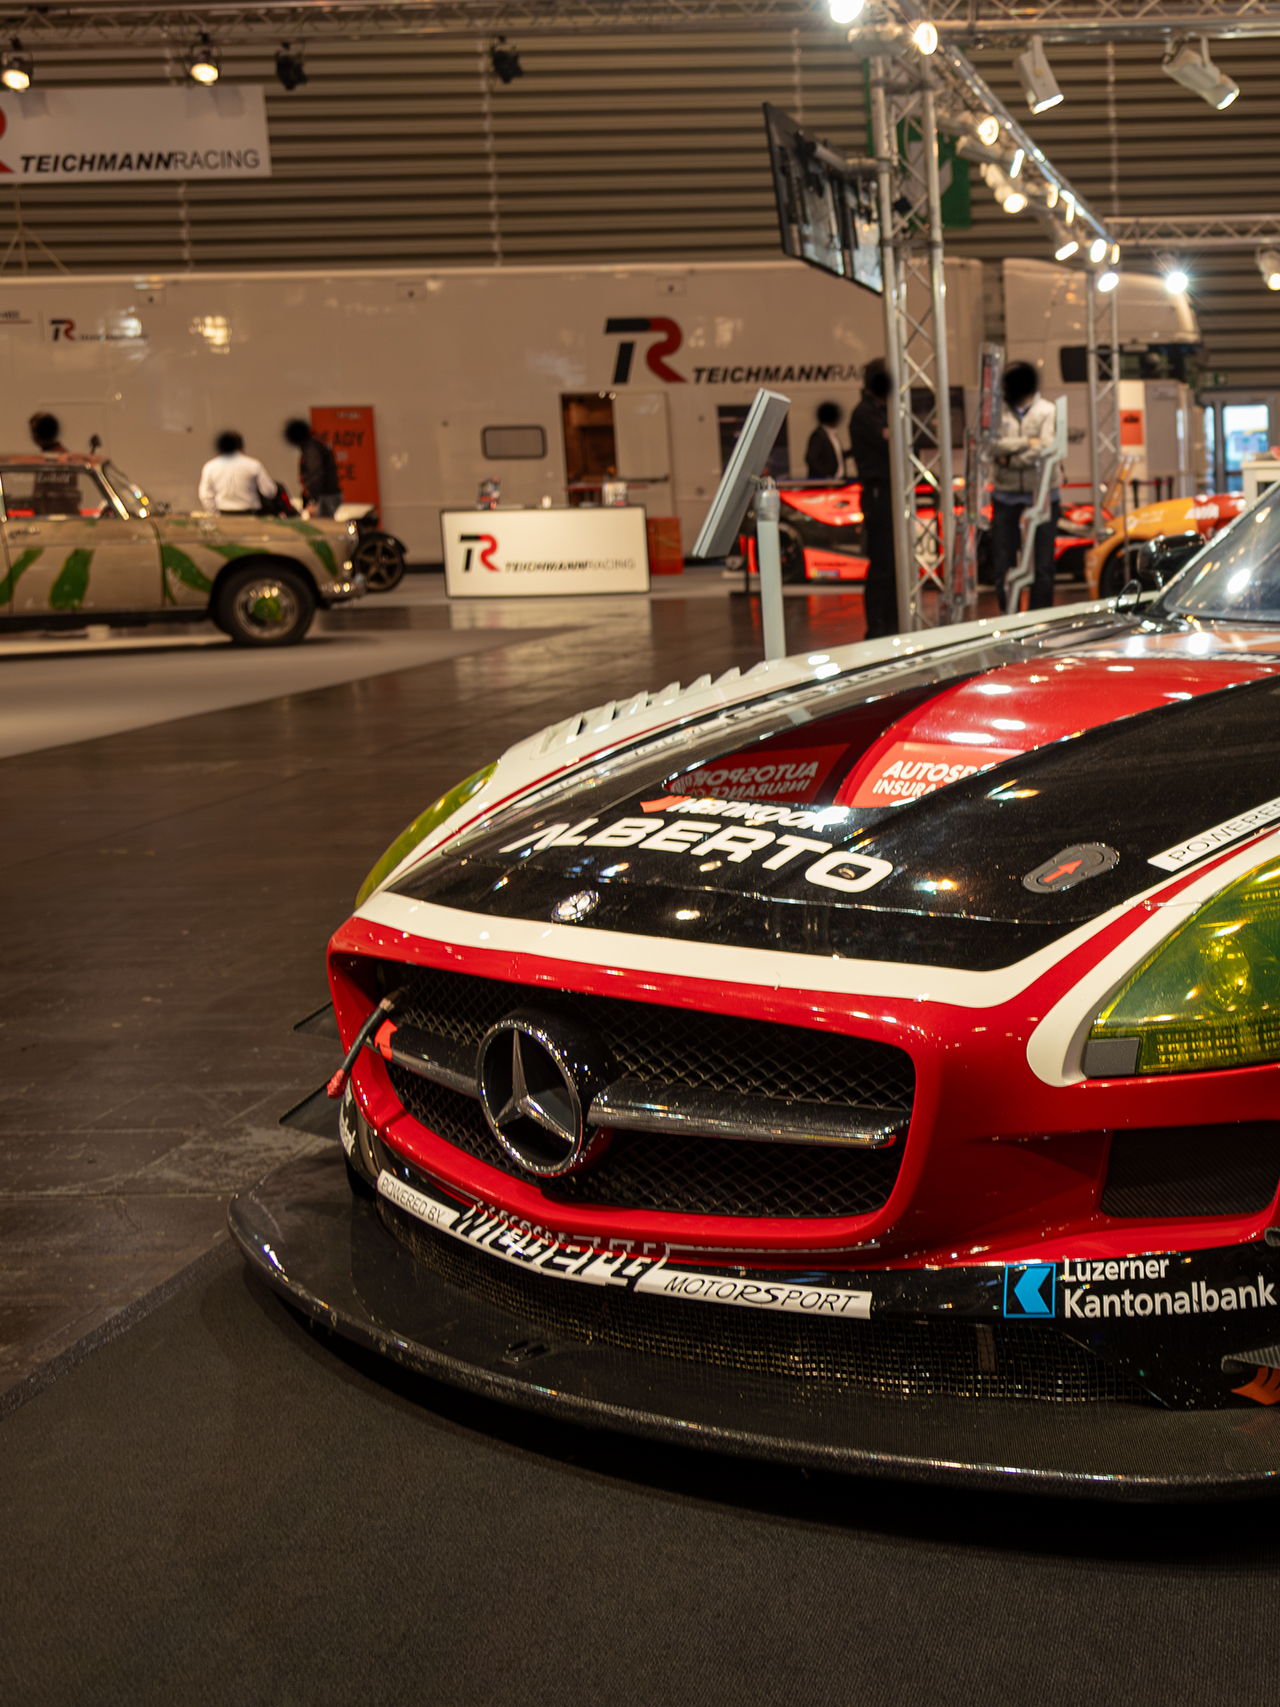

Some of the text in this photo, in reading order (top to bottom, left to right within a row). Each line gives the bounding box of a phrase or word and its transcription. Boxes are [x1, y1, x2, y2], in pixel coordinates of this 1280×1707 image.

[500, 817, 894, 893] ALBERTO
[380, 1176, 428, 1216] POWERED
[426, 1205, 444, 1225] BY
[663, 1274, 861, 1314] MOTORSPORT
[1062, 1256, 1170, 1284] Luzerner
[1062, 1275, 1279, 1320] Kantonalbank
